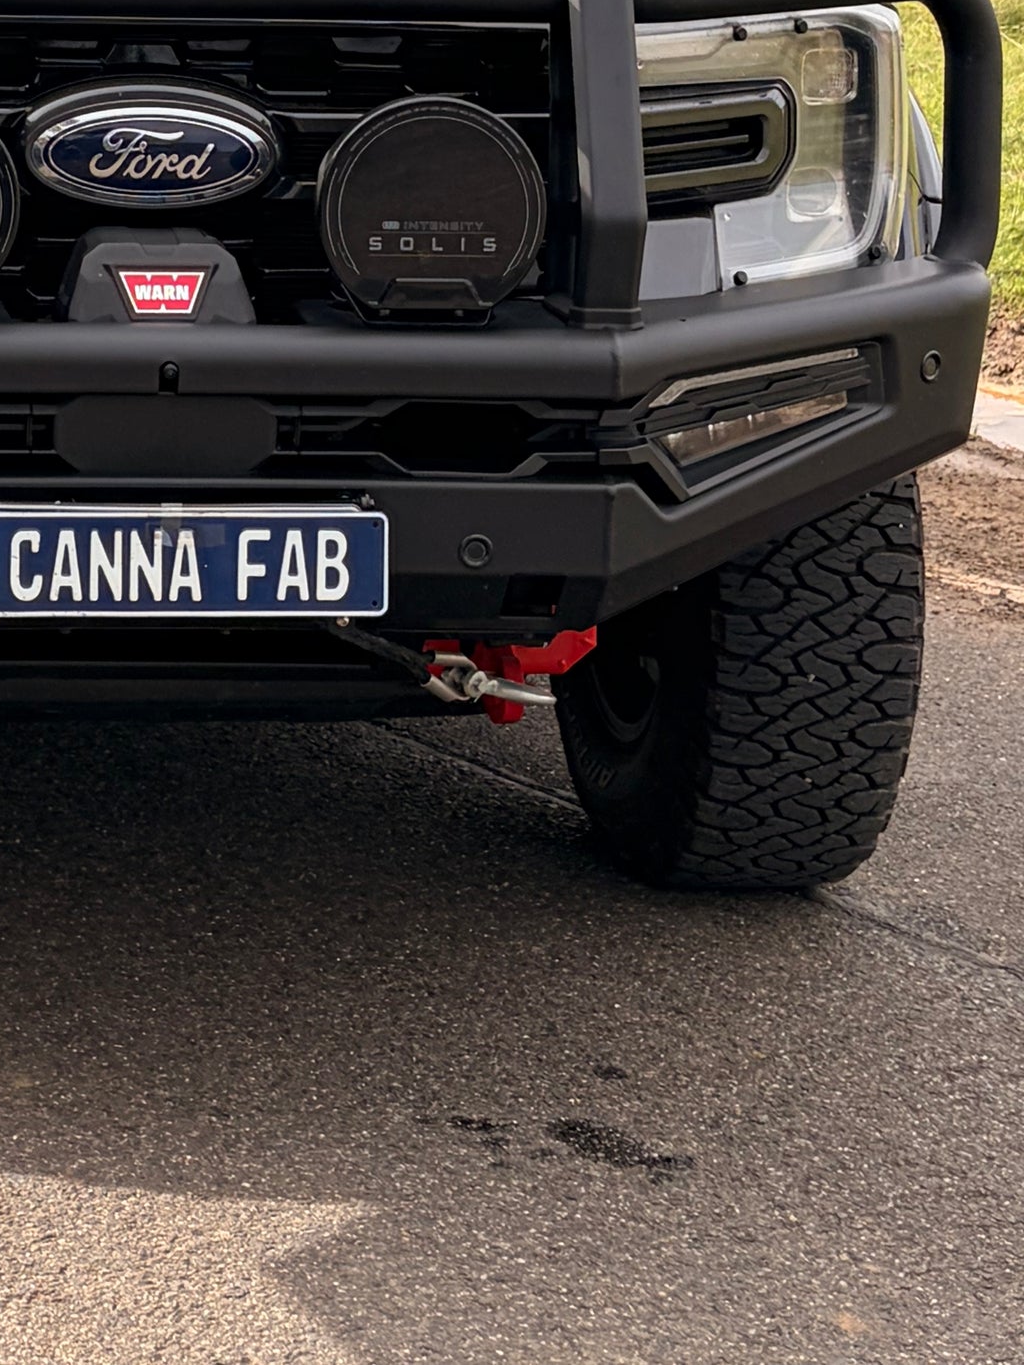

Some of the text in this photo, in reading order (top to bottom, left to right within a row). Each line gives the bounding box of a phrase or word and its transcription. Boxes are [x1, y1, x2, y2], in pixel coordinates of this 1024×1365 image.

[89, 127, 215, 179] Ford
[403, 220, 483, 231] INTENSITY
[369, 236, 496, 252] SOLIS
[134, 284, 190, 301] WARN
[10, 529, 350, 602] CANNA FAB
